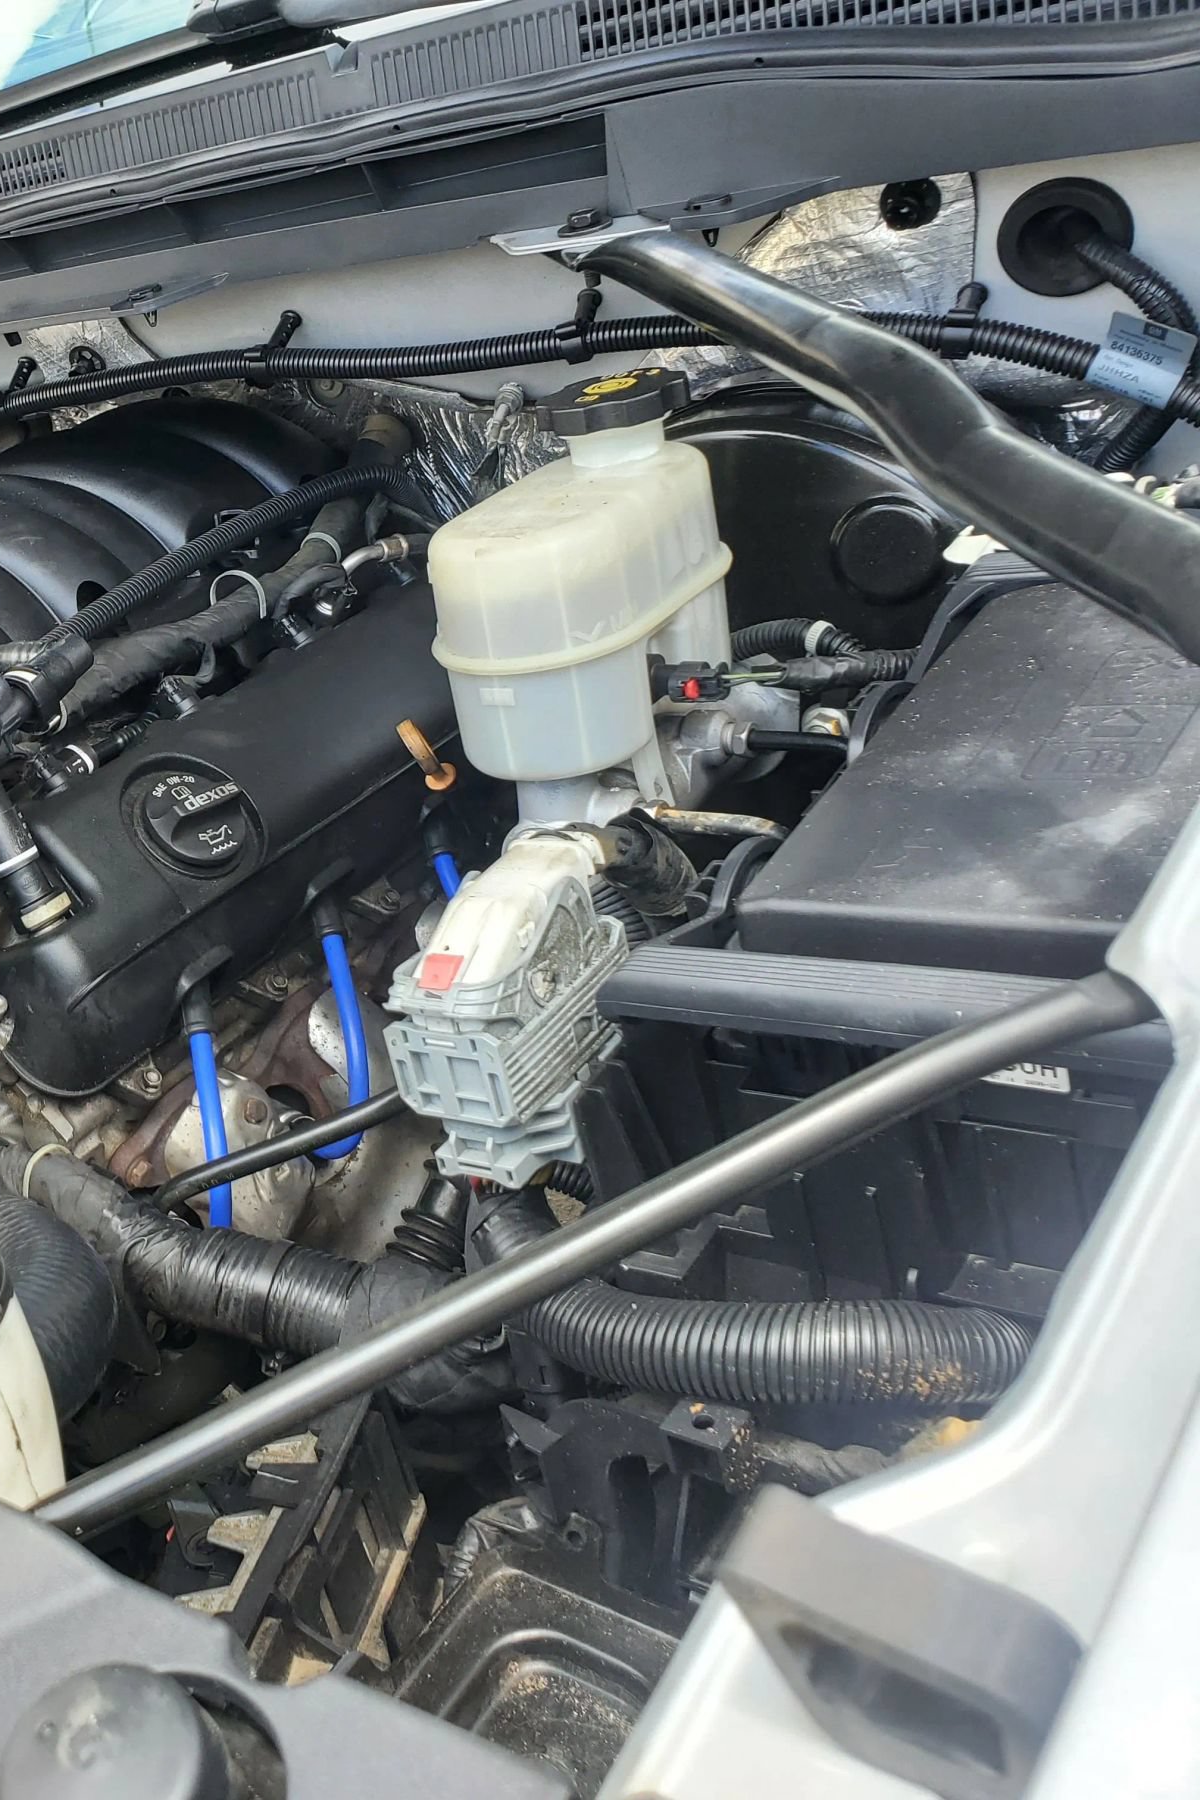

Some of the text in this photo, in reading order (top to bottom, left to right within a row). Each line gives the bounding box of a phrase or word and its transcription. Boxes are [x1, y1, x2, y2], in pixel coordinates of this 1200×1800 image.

[1110, 340, 1164, 365] 84136375
[152, 775, 196, 798] SAE 0W-20
[183, 782, 239, 811] dexos
